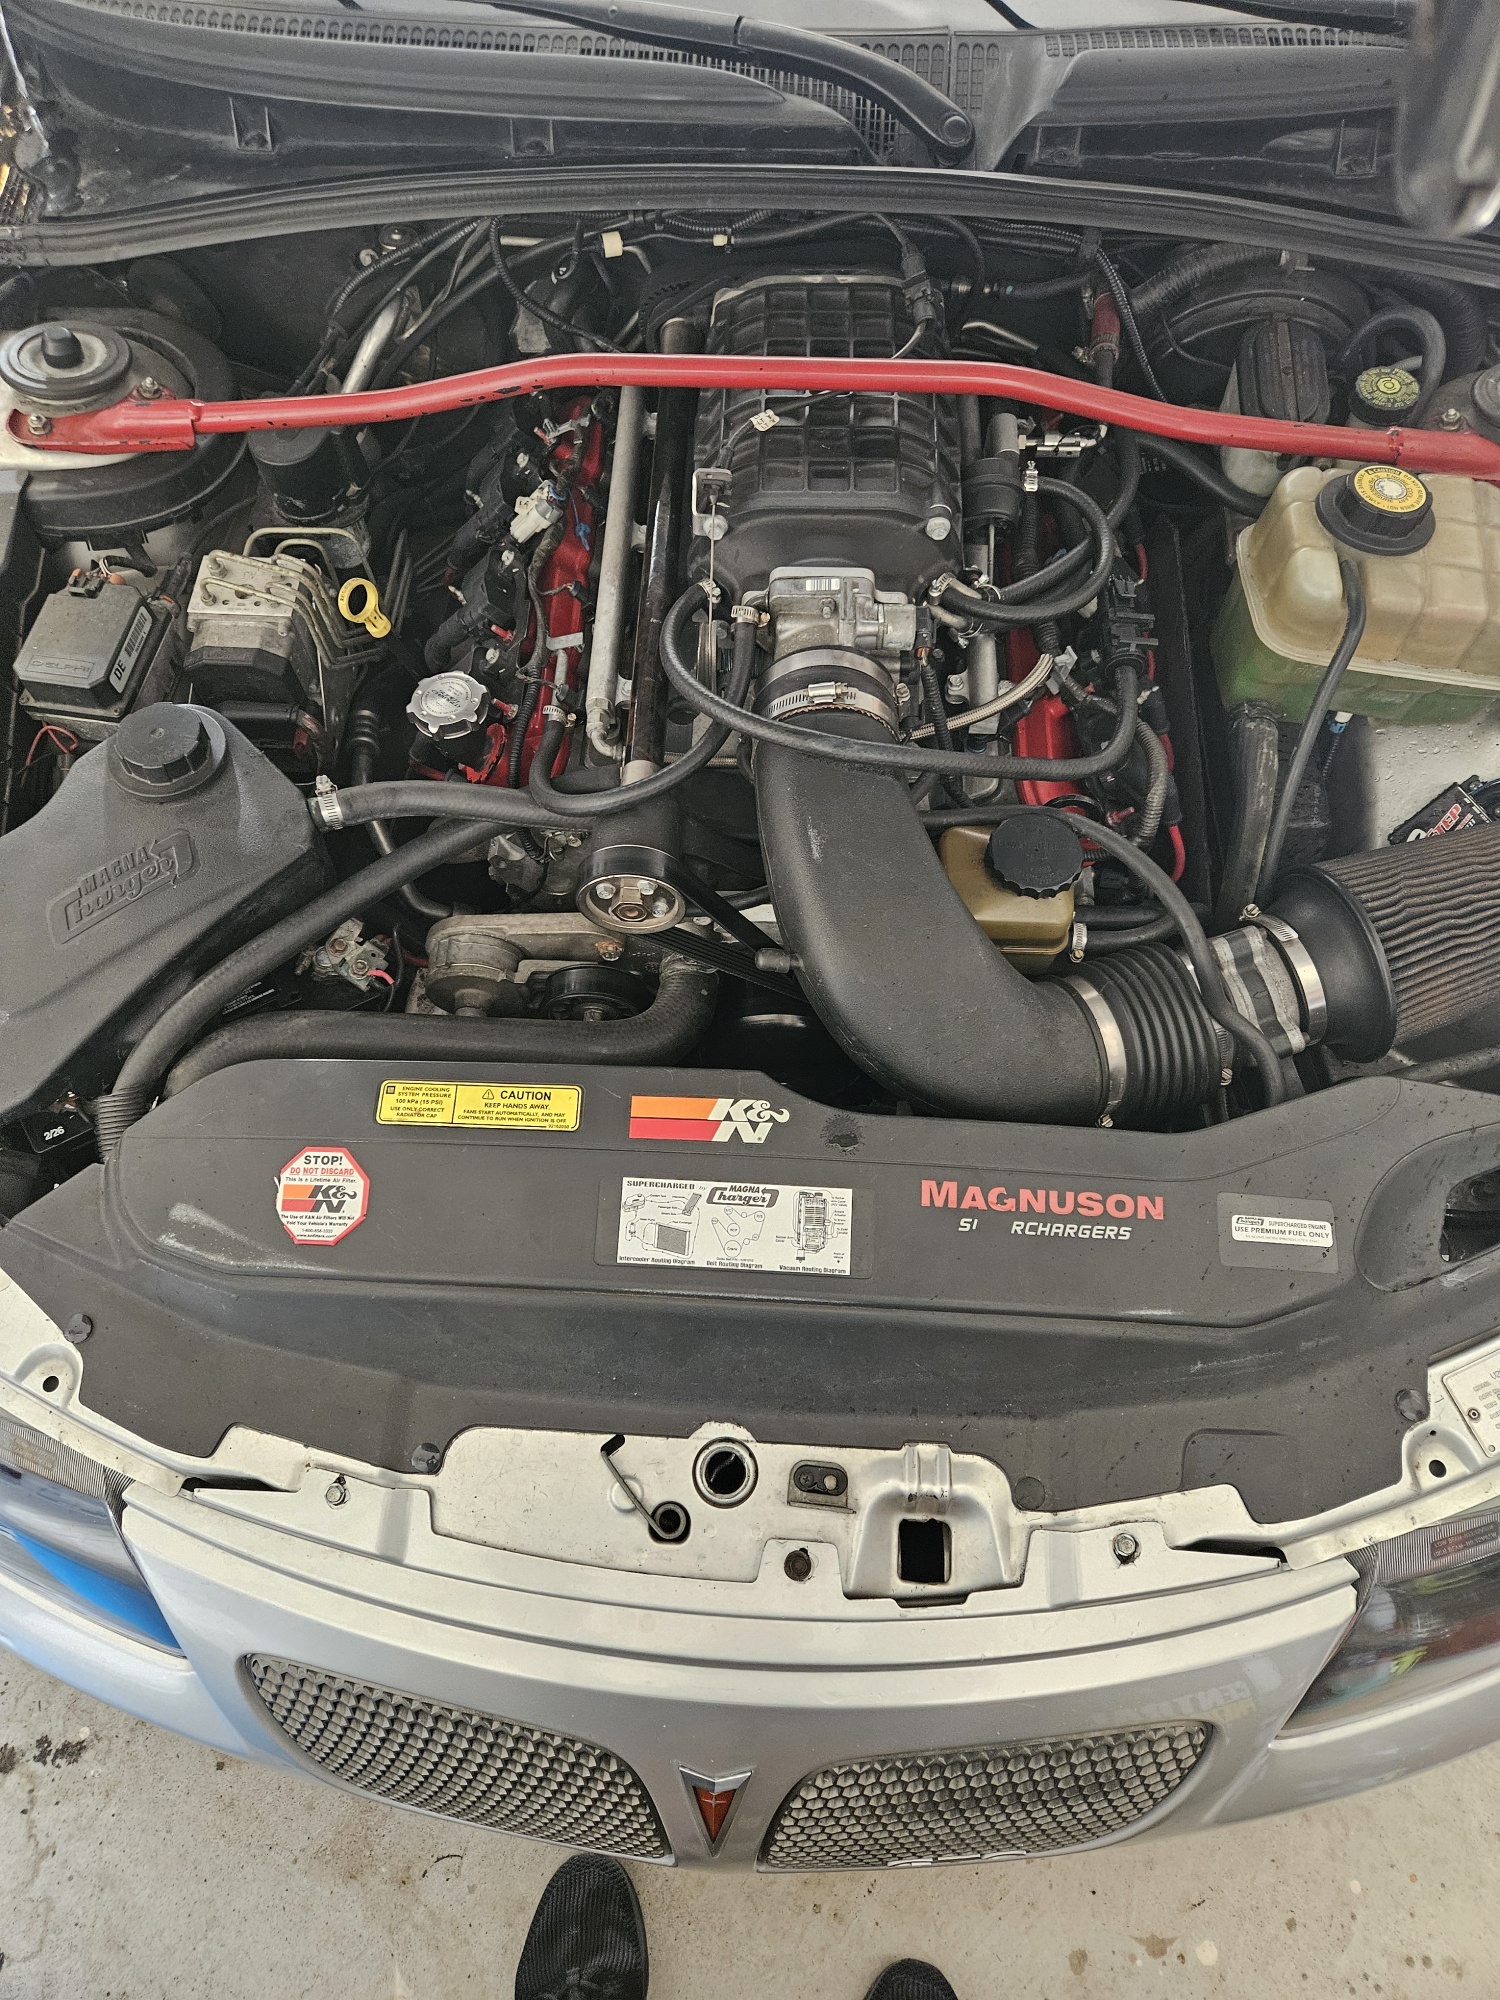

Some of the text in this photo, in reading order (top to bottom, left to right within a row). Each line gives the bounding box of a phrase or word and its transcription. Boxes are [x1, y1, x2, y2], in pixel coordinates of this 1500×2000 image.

[113, 659, 127, 681] DE
[82, 846, 150, 896] MAGNA
[500, 1090, 552, 1101] CAUTION
[43, 1126, 65, 1141] 2/26
[303, 1155, 343, 1166] STOP!
[303, 1167, 319, 1175] NOT
[626, 1180, 695, 1190] SUPERCHARGED
[729, 1185, 760, 1194] MAGNA
[307, 1184, 357, 1213] K&N
[920, 1178, 1164, 1220] MAGNUSON
[1268, 1220, 1307, 1229] SUPERCHARGED
[1250, 1227, 1287, 1236] PREMIUM
[1308, 1231, 1330, 1239] ONLY
